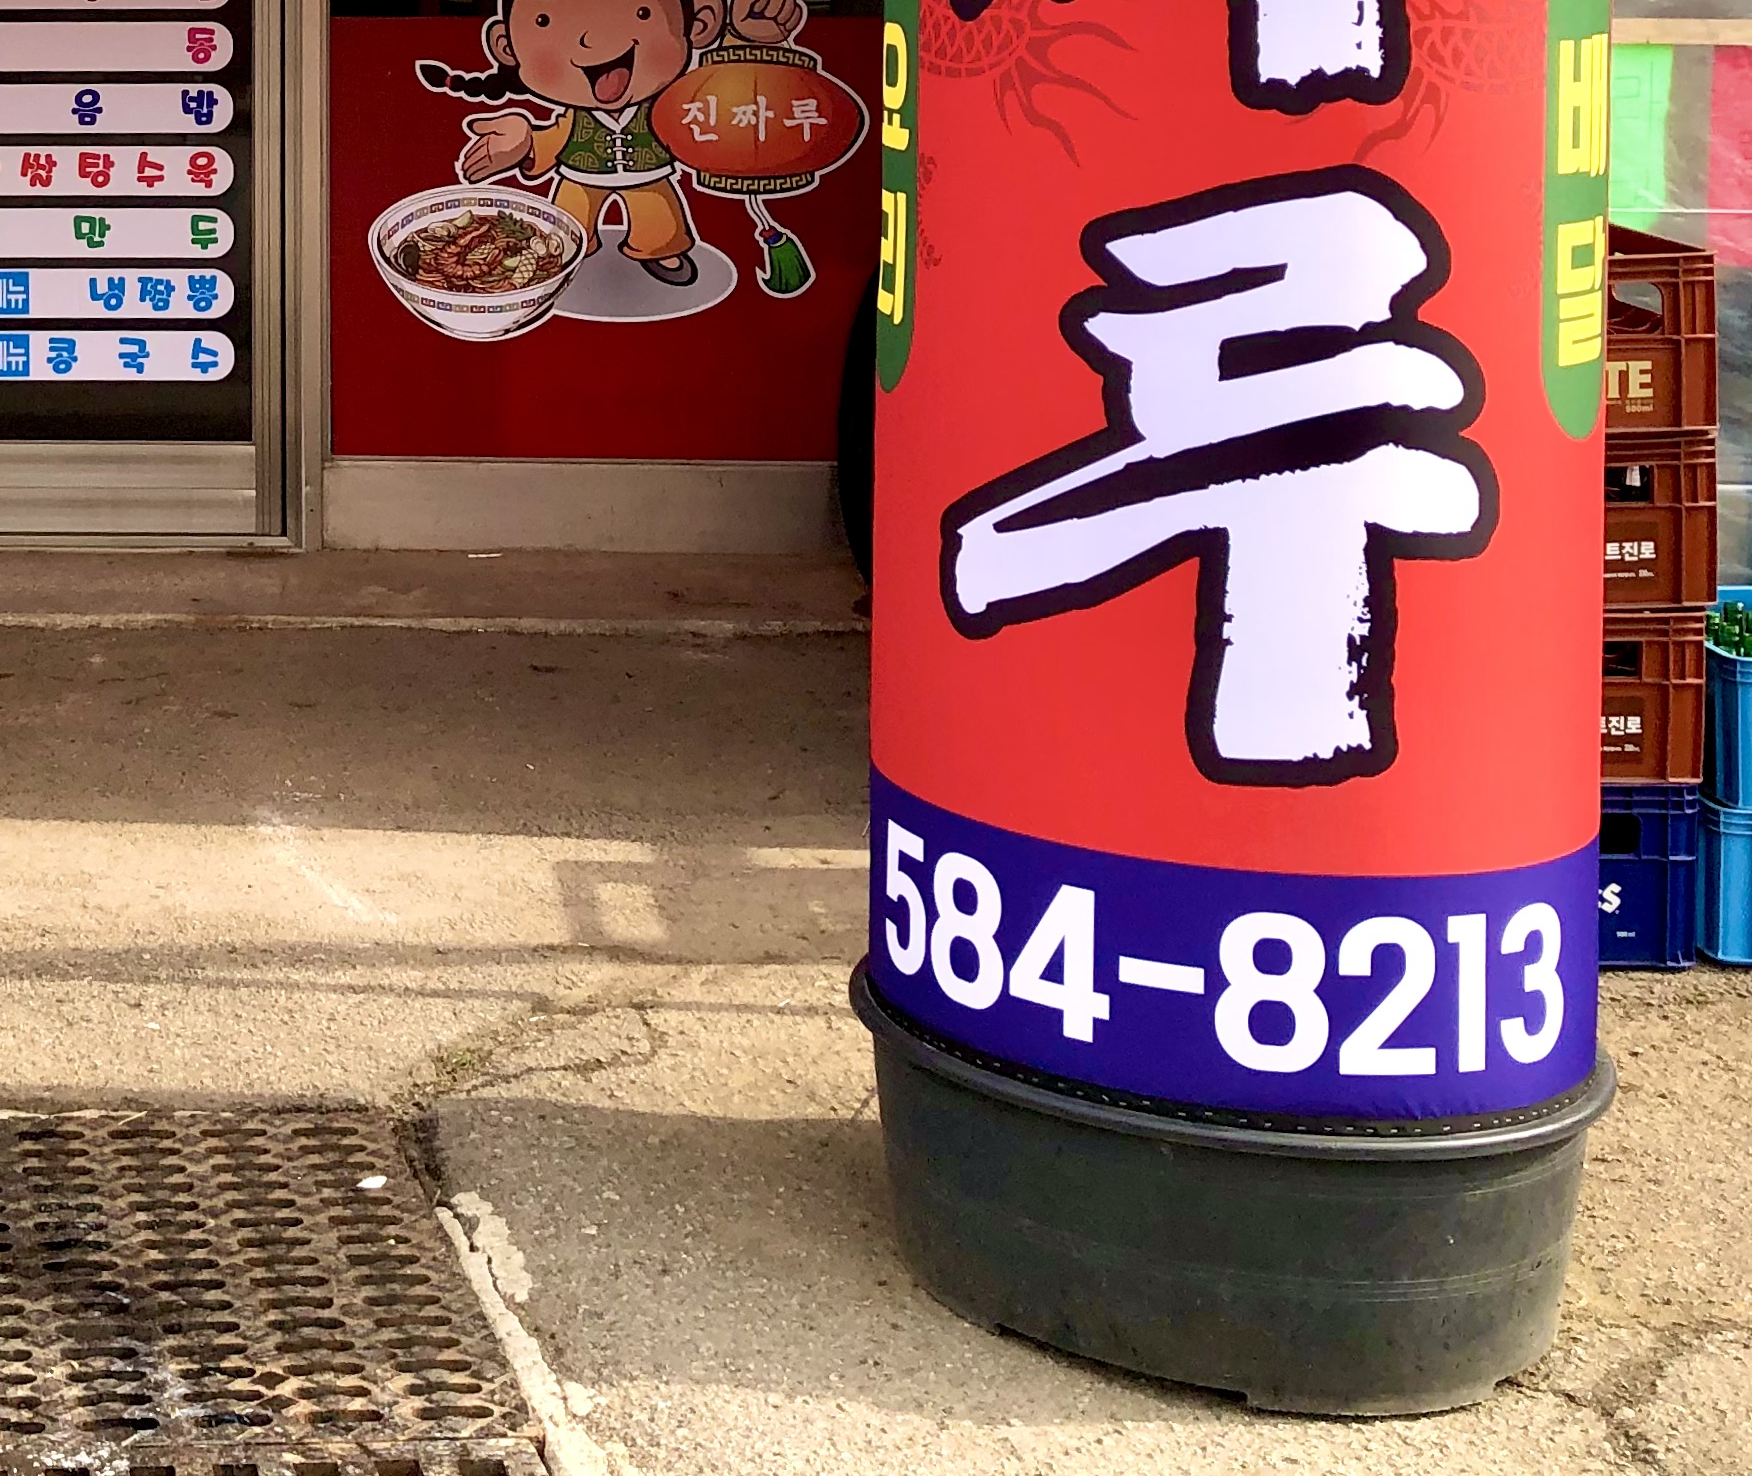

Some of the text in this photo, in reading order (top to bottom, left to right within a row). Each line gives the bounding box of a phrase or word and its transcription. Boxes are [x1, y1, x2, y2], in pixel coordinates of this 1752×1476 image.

[680, 94, 828, 143] 진짜루
[88, 274, 219, 312] 냉짬뽕
[46, 336, 219, 375] 콩국수
[1605, 360, 1654, 399] TE
[1604, 540, 1657, 562] 트진로
[884, 817, 1566, 1077] 584-8213
